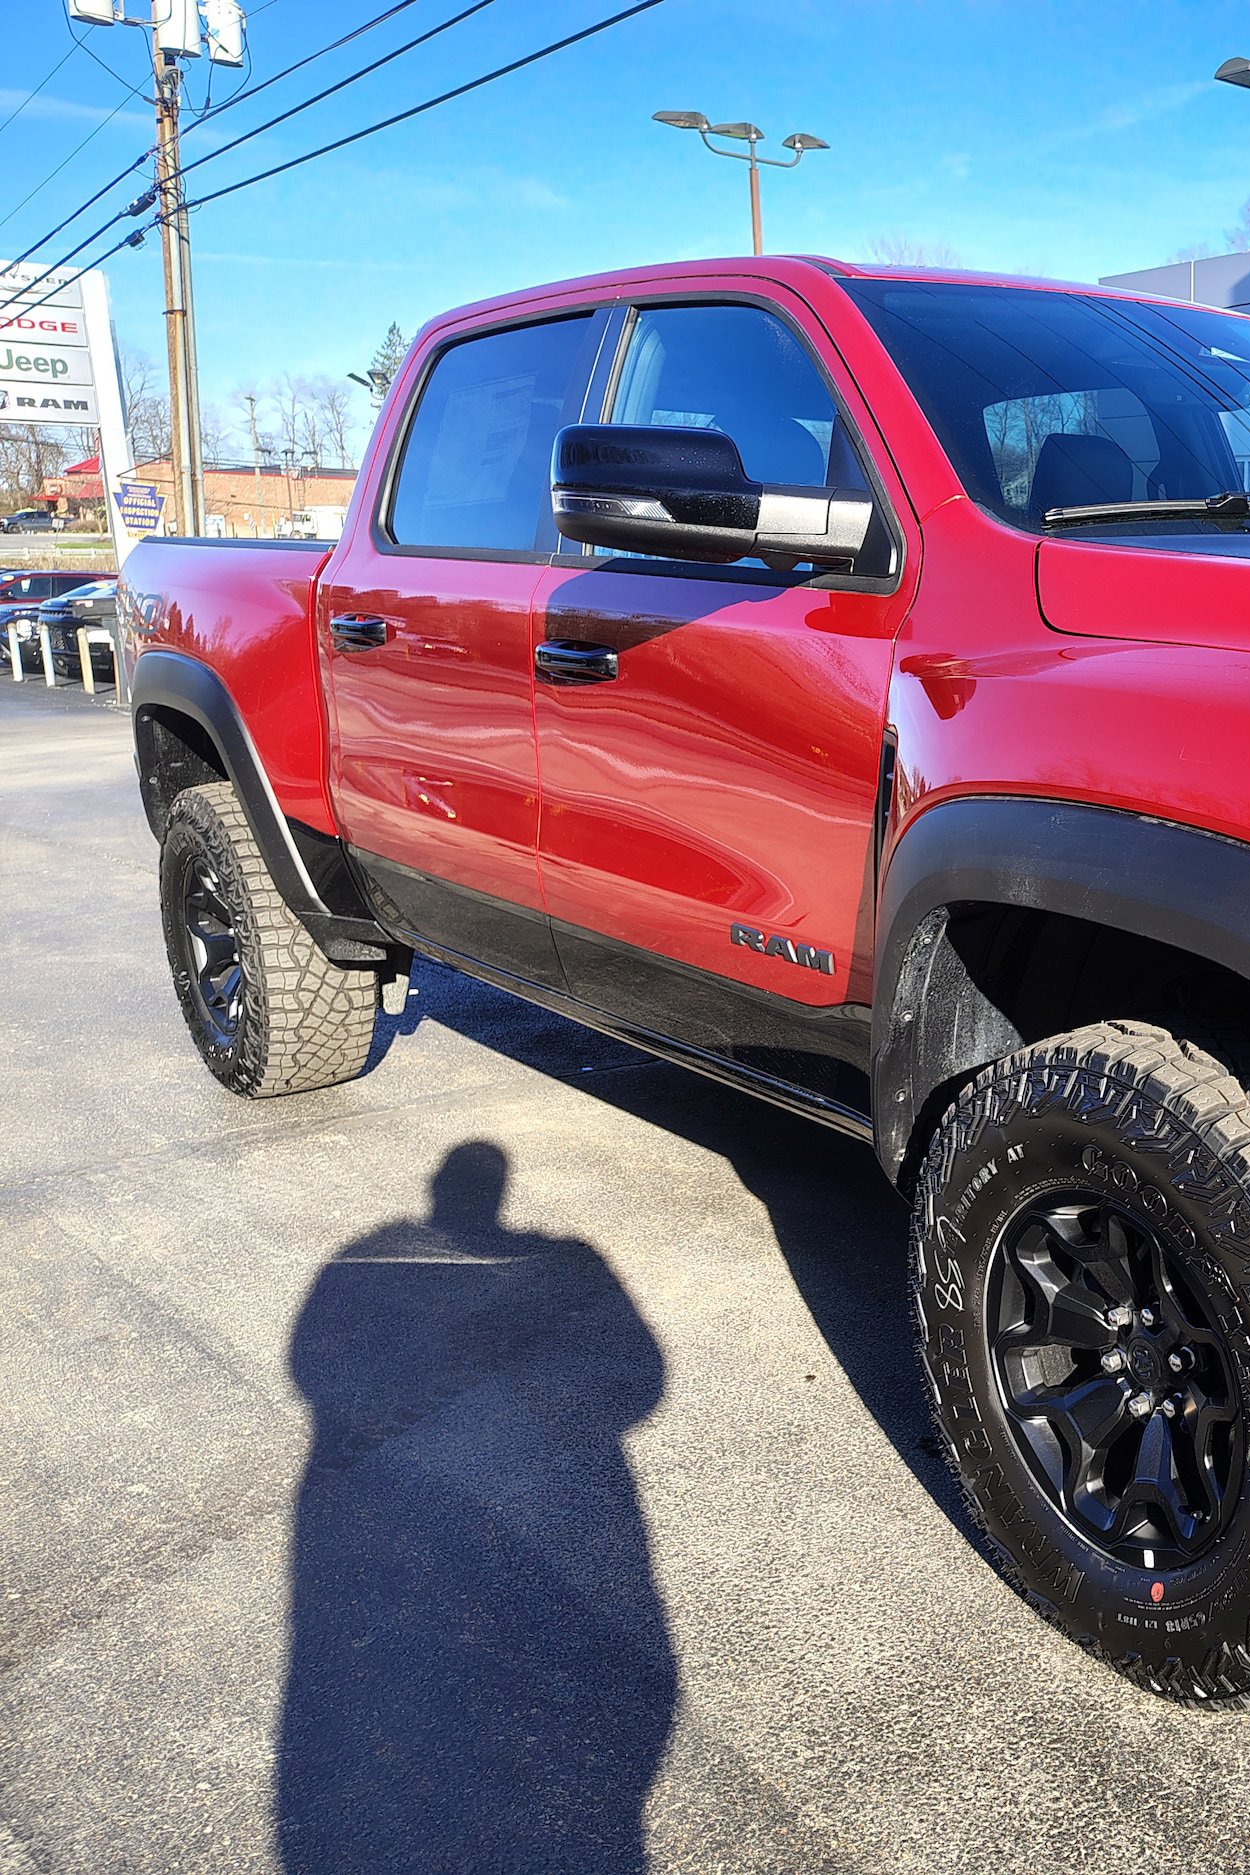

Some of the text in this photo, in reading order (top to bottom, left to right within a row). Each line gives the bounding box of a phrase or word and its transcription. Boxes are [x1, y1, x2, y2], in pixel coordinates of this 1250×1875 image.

[0, 348, 68, 378] Jeep
[16, 396, 89, 411] RAM
[123, 496, 157, 507] OFFICIAL
[125, 516, 155, 526] STATION
[730, 921, 836, 976] RAM
[1006, 1143, 1025, 1164] AT
[938, 1322, 1086, 1605] WRANGLER
